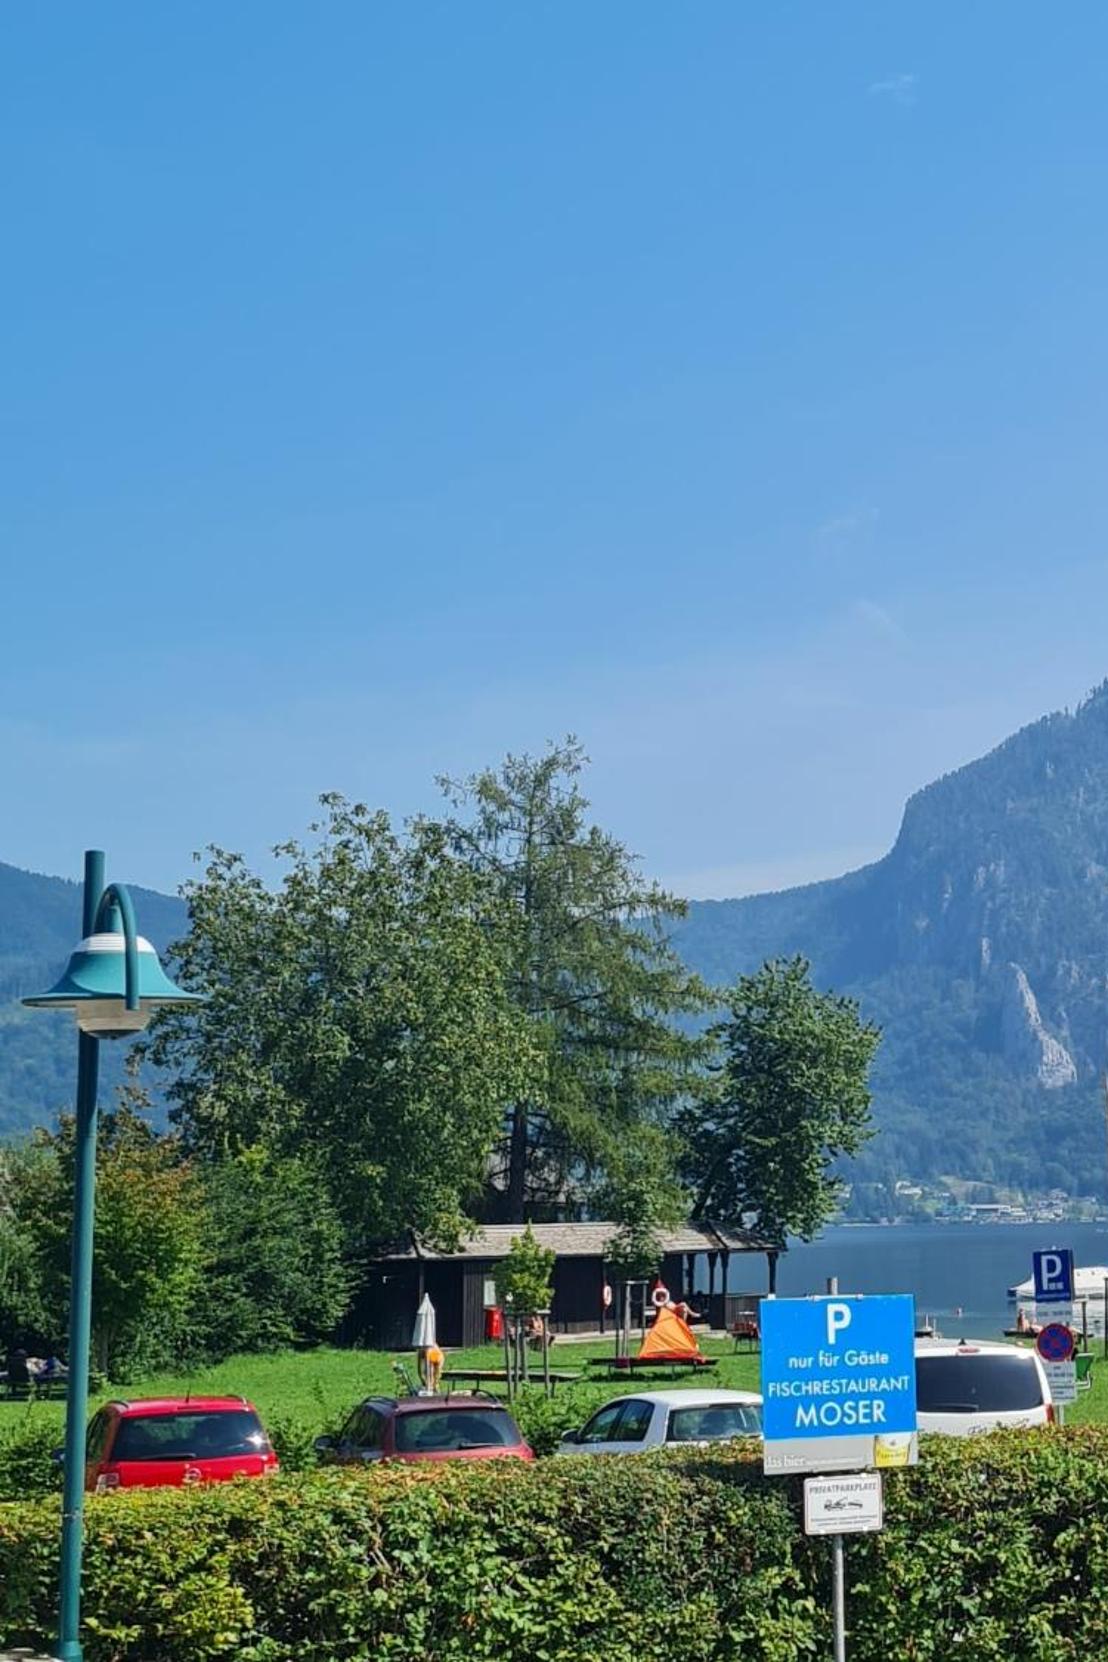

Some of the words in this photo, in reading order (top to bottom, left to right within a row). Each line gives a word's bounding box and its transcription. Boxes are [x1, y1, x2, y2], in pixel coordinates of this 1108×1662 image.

[1041, 1255, 1062, 1290] P
[827, 1303, 851, 1344] P
[789, 1357, 813, 1368] nur
[818, 1351, 839, 1368] für
[844, 1350, 889, 1366] Gäste
[768, 1376, 910, 1397] FISCHRESTAURANT
[796, 1400, 886, 1428] MOSER
[809, 1482, 876, 1494] PRIVATPARKPLATZ
